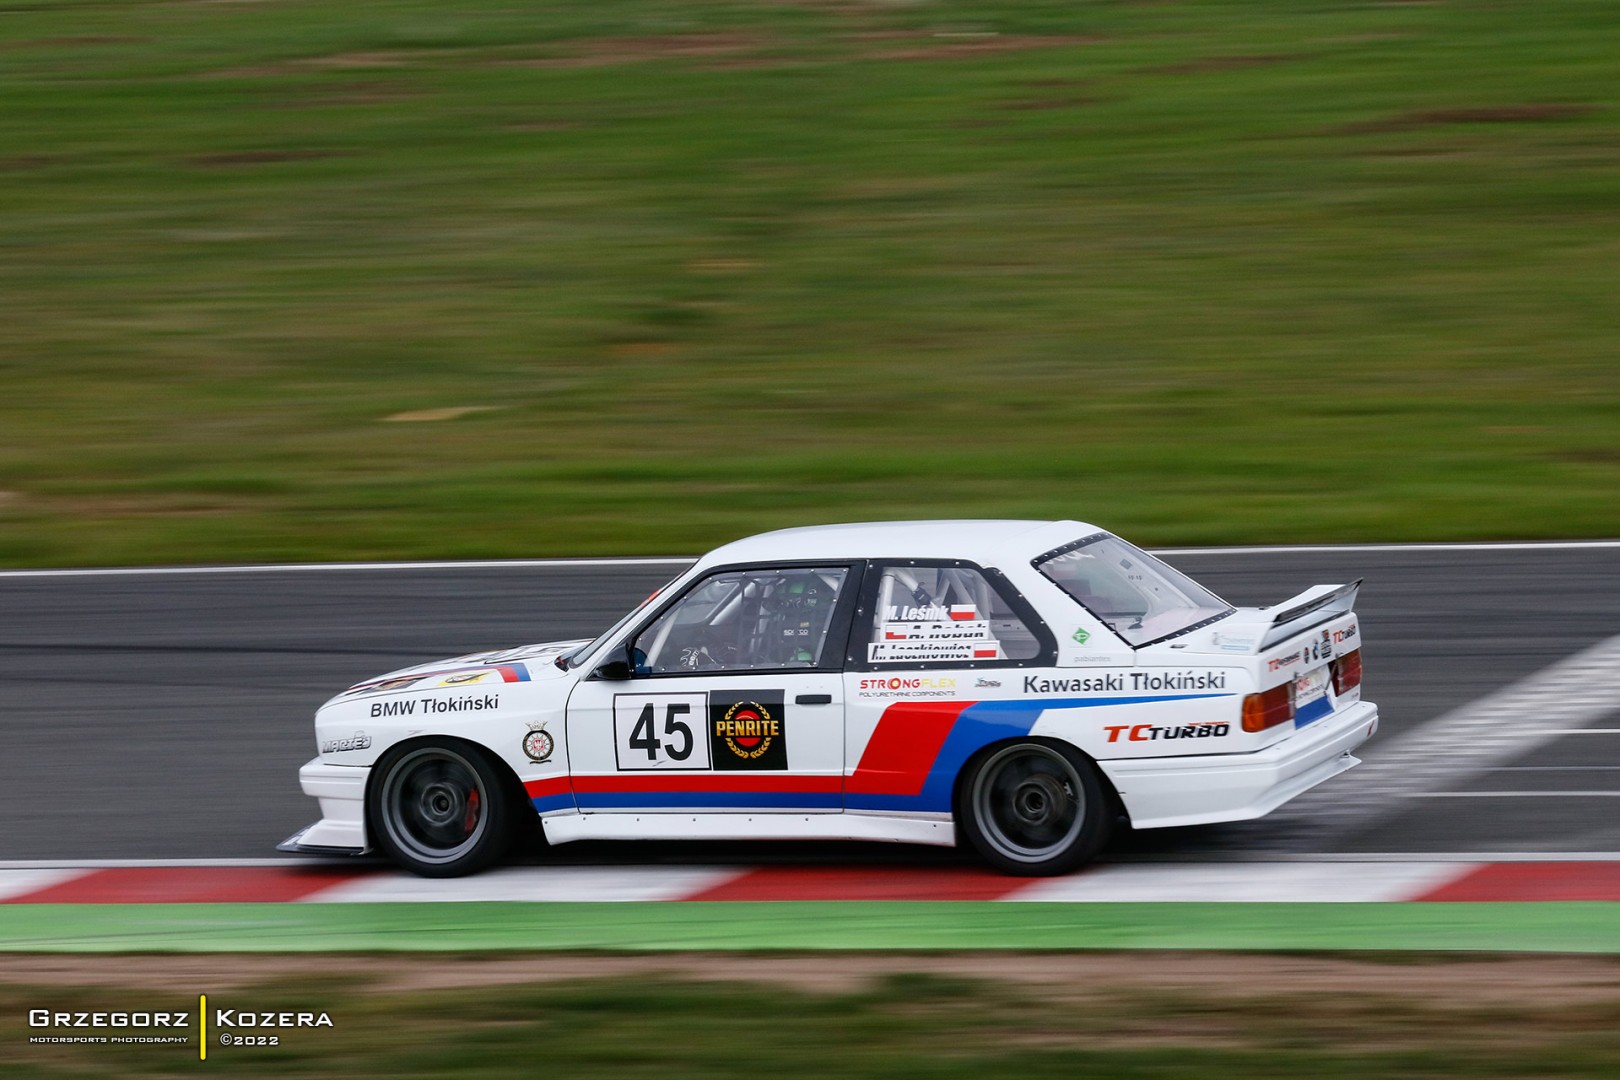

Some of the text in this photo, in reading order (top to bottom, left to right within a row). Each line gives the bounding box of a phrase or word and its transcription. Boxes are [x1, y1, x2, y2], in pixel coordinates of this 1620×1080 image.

[860, 677, 956, 690] STRONGFLEX
[1023, 673, 1124, 693] Kawasaki
[1130, 671, 1226, 690] Tłokiński
[371, 694, 499, 717] BMW Tłokiński
[629, 703, 694, 761] 45
[716, 720, 779, 736] PENRITE
